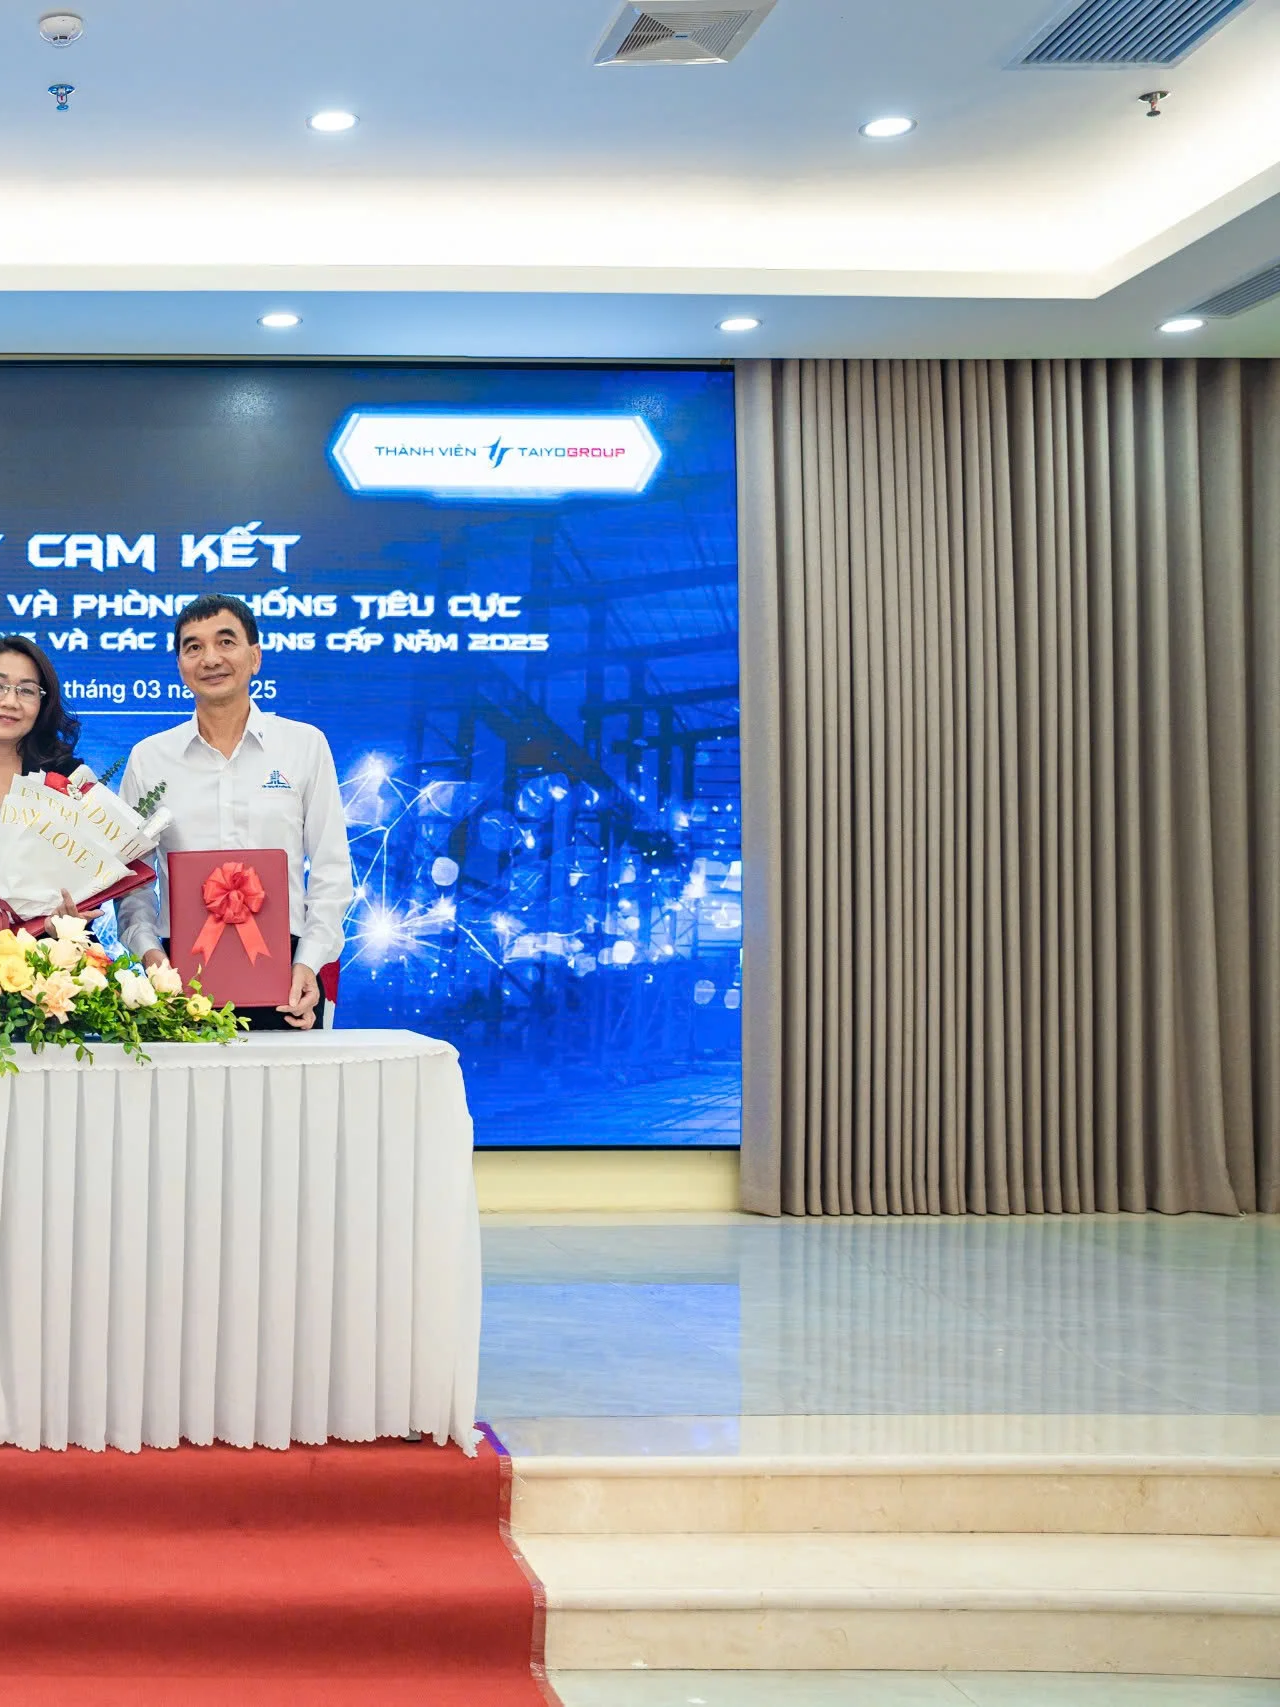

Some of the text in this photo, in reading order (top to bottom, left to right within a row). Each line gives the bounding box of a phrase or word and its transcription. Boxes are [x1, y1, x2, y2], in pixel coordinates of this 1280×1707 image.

[374, 443, 626, 458] THÀNH VIÊN TAIYOGROUP
[28, 534, 155, 572] CAM
[181, 521, 301, 573] KẾT
[7, 589, 58, 619] VÀ
[228, 586, 337, 620] HỐNG
[352, 590, 435, 620] TIÊU
[447, 593, 522, 622] CỰC
[48, 627, 89, 652] VÀ
[100, 627, 157, 652] CÁC
[259, 631, 316, 652] UNG
[326, 626, 384, 653] CẤP
[394, 629, 458, 653] NĂM
[468, 633, 549, 651] 2025
[63, 678, 126, 704] tháng
[132, 679, 161, 699] 03
